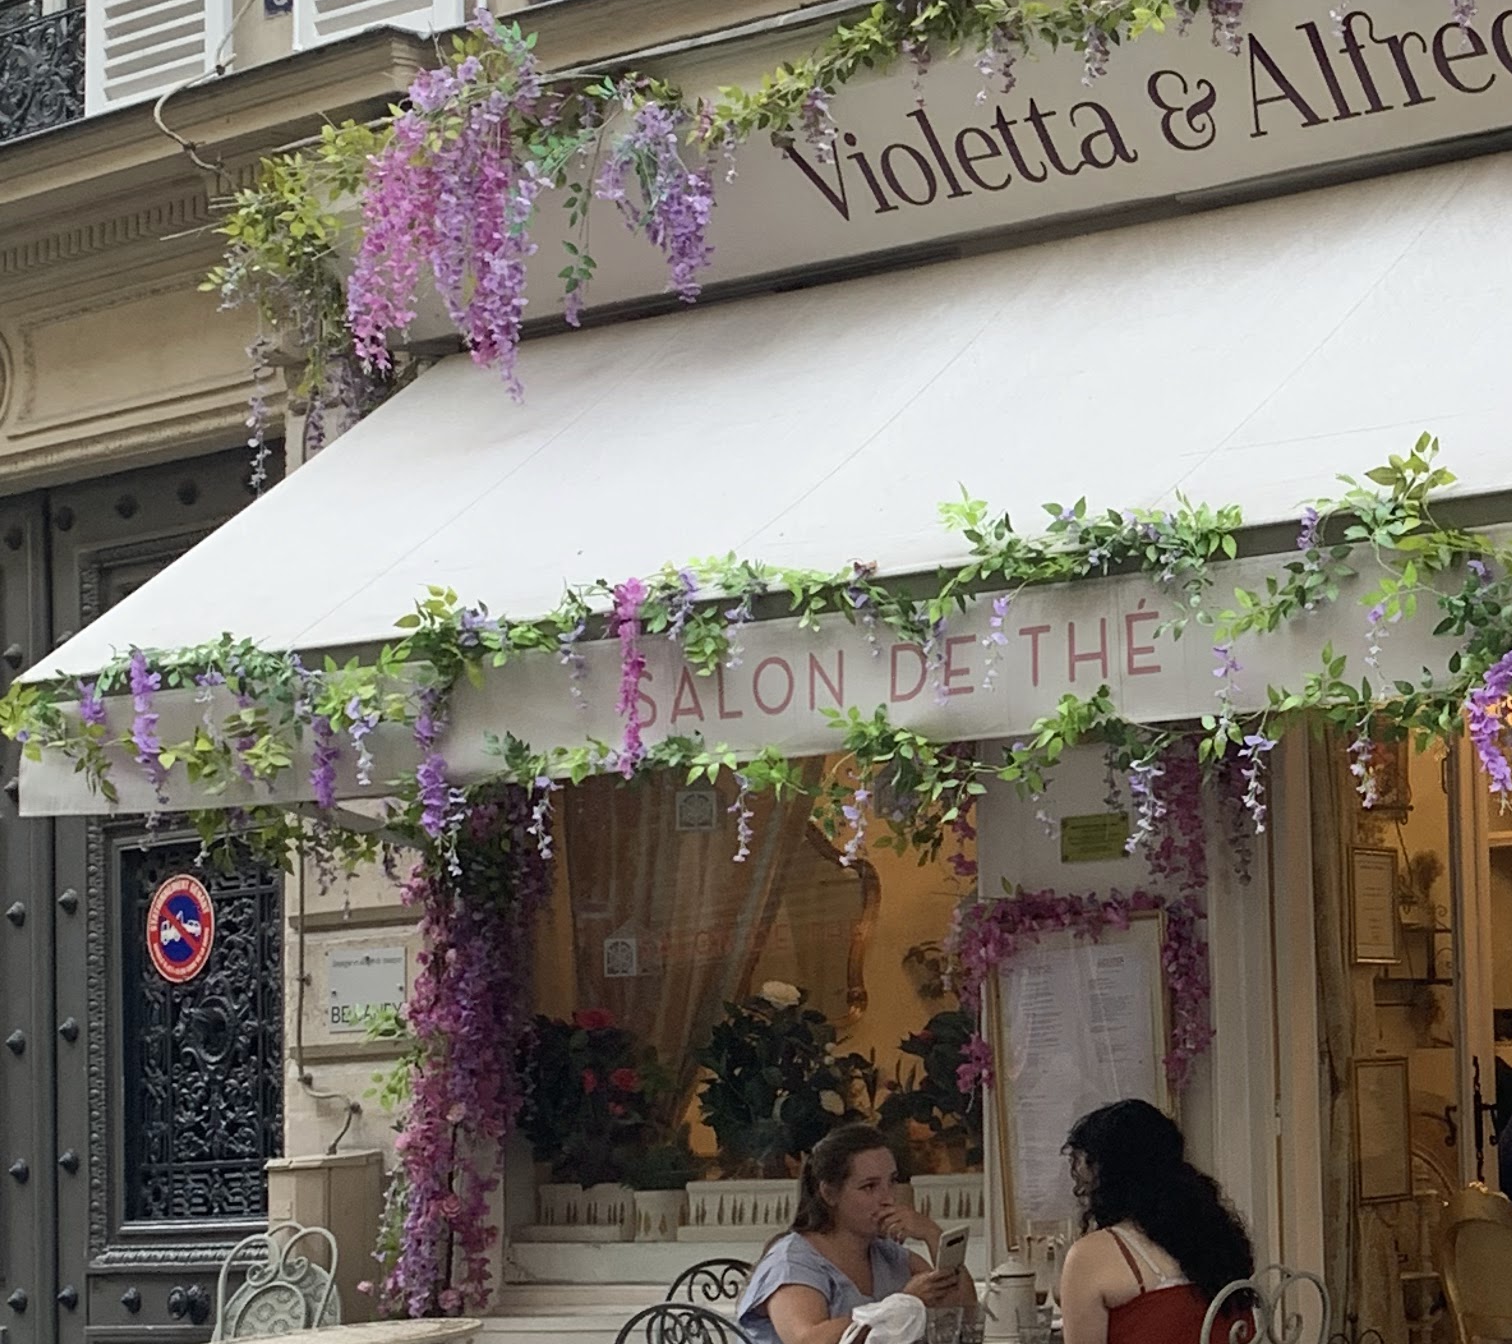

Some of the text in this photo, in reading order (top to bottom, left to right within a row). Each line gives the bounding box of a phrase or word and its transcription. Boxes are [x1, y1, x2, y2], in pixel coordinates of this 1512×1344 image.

[771, 93, 1138, 221] Violetta
[1147, 68, 1217, 151] &
[633, 598, 1162, 729] SALON DE THÉ
